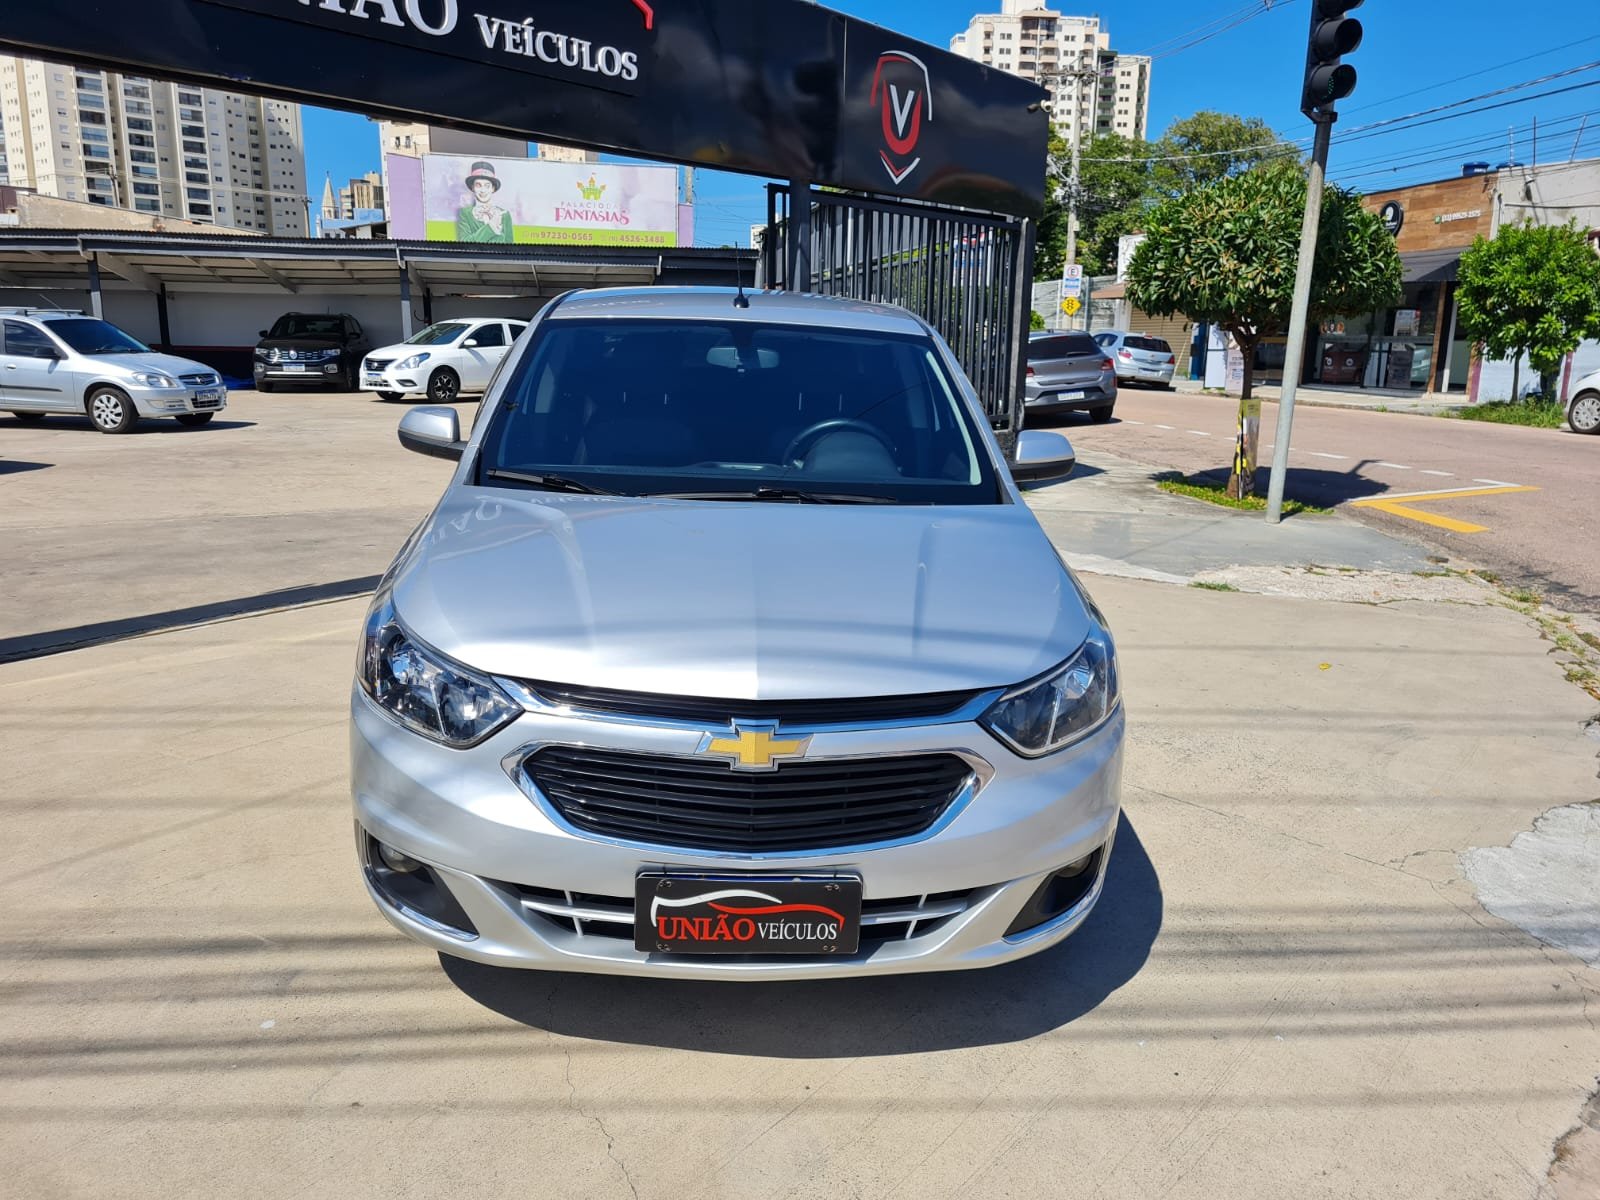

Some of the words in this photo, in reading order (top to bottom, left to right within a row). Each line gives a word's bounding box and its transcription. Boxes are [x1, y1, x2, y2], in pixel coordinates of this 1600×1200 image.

[474, 13, 638, 81] VEÍCULOS
[554, 207, 630, 225] FANTASIAS
[657, 913, 756, 941] UNIÃO
[758, 918, 838, 941] VEÍCULOS
